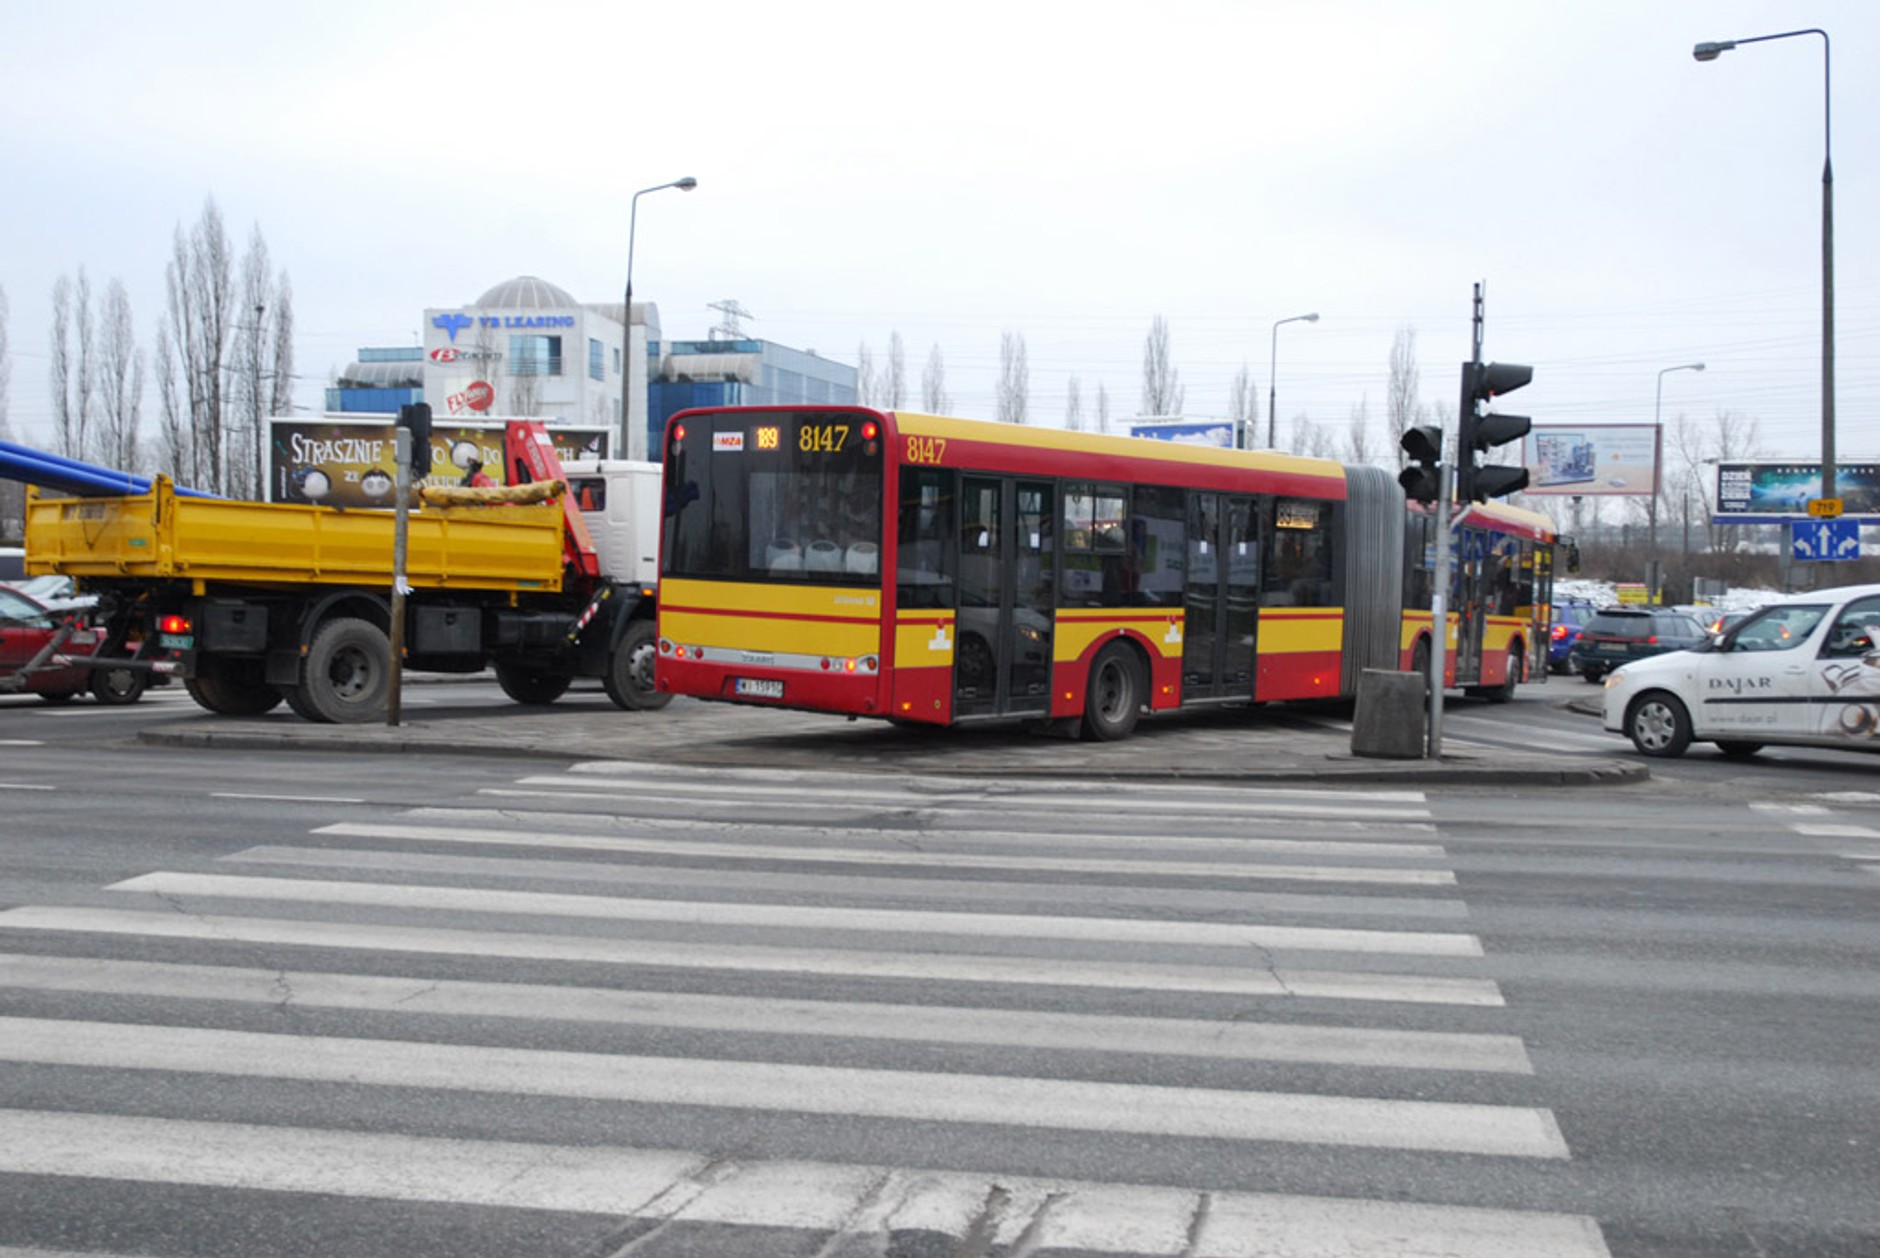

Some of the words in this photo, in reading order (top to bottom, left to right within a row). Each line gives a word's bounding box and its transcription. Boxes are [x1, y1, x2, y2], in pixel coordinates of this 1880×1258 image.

[479, 316, 501, 328] VB
[505, 316, 575, 328] LEASING
[757, 427, 778, 448] 189
[799, 425, 849, 452] 8147
[291, 432, 383, 465] STRASZNIE
[907, 436, 946, 463] 8147
[1816, 502, 1836, 513] 719
[1709, 677, 1772, 694] DAJAR
